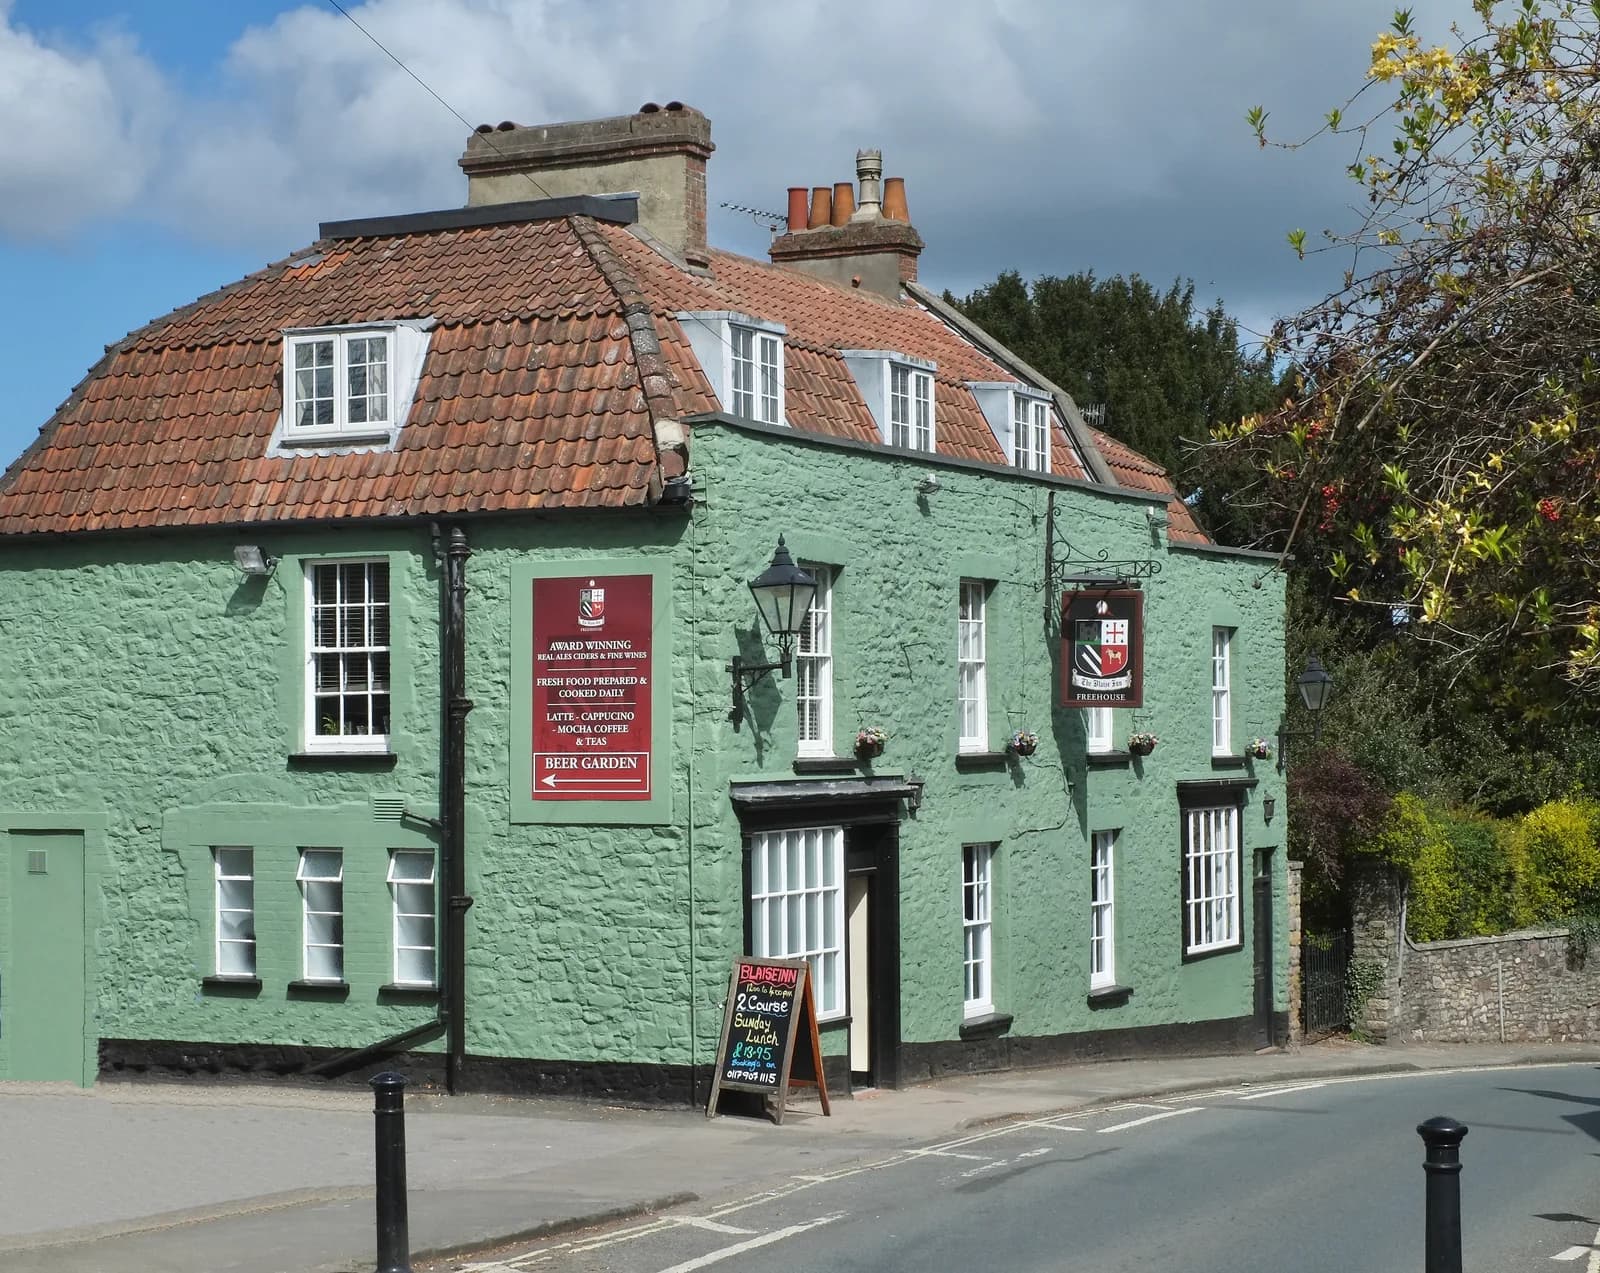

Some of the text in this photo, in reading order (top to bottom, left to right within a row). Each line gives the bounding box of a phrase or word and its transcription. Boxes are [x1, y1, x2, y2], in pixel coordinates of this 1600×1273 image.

[550, 640, 632, 651] AWARD WINNING
[537, 653, 554, 661] REAL
[573, 652, 598, 660] CIDERS
[624, 651, 647, 659] WINES
[537, 676, 647, 686] FRESH FOOD PREPARED &
[558, 688, 625, 698] COOKED DAILY
[1076, 693, 1126, 701] FREEHOUSE
[546, 712, 574, 721] LATTE
[581, 711, 635, 721] CAPPUCINO
[557, 725, 592, 734] MOCHA
[594, 724, 629, 733] COFFEE
[575, 737, 607, 746] & TEAS
[545, 757, 638, 769] BEER GARDEN
[736, 993, 789, 1012] 2 Course
[734, 1013, 771, 1033] Sunday
[745, 1030, 779, 1046] Lunch
